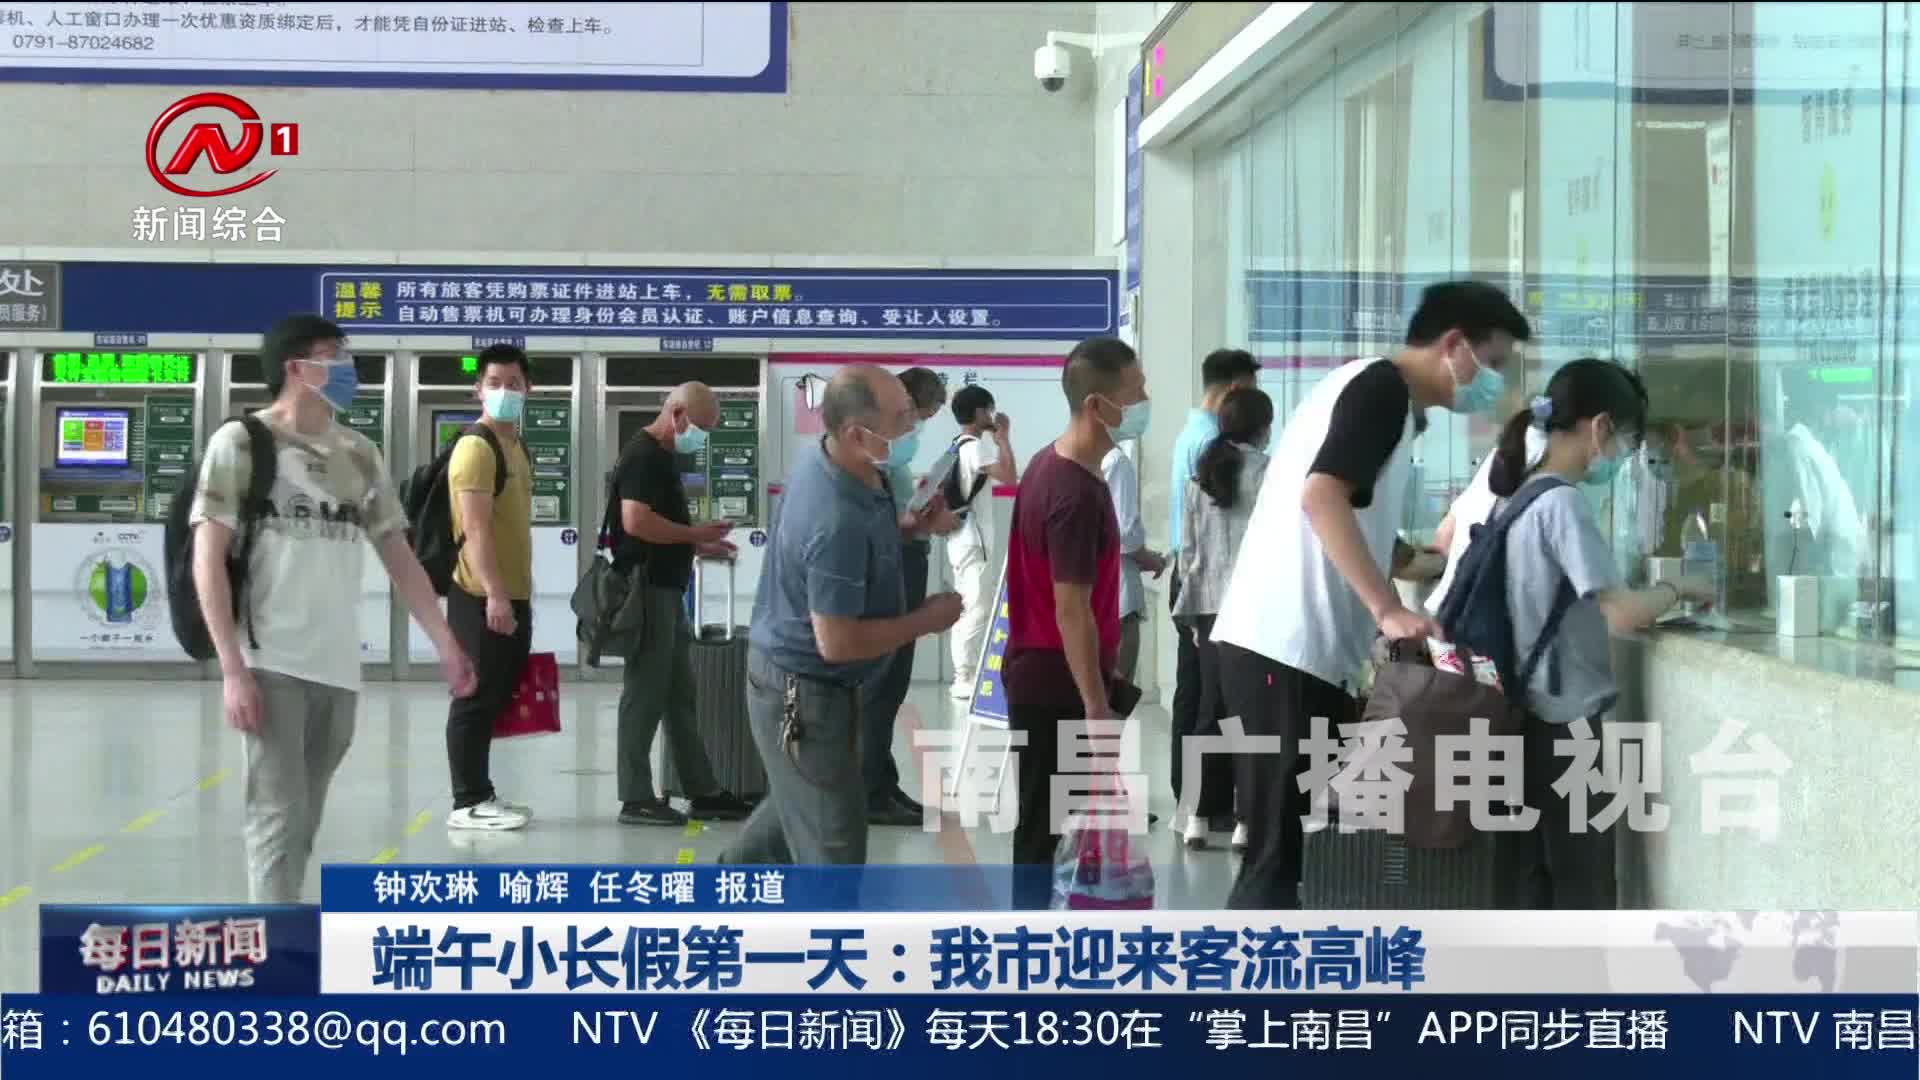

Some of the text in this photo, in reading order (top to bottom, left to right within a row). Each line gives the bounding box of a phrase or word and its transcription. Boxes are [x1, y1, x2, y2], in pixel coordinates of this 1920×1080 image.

[12, 34, 155, 50] 0791-87024682
[335, 281, 383, 299] 温馨
[335, 302, 383, 319] 提示
[397, 305, 1001, 327] 自动售票机可办理身份会员认证、账户信息查询、受让人设置。
